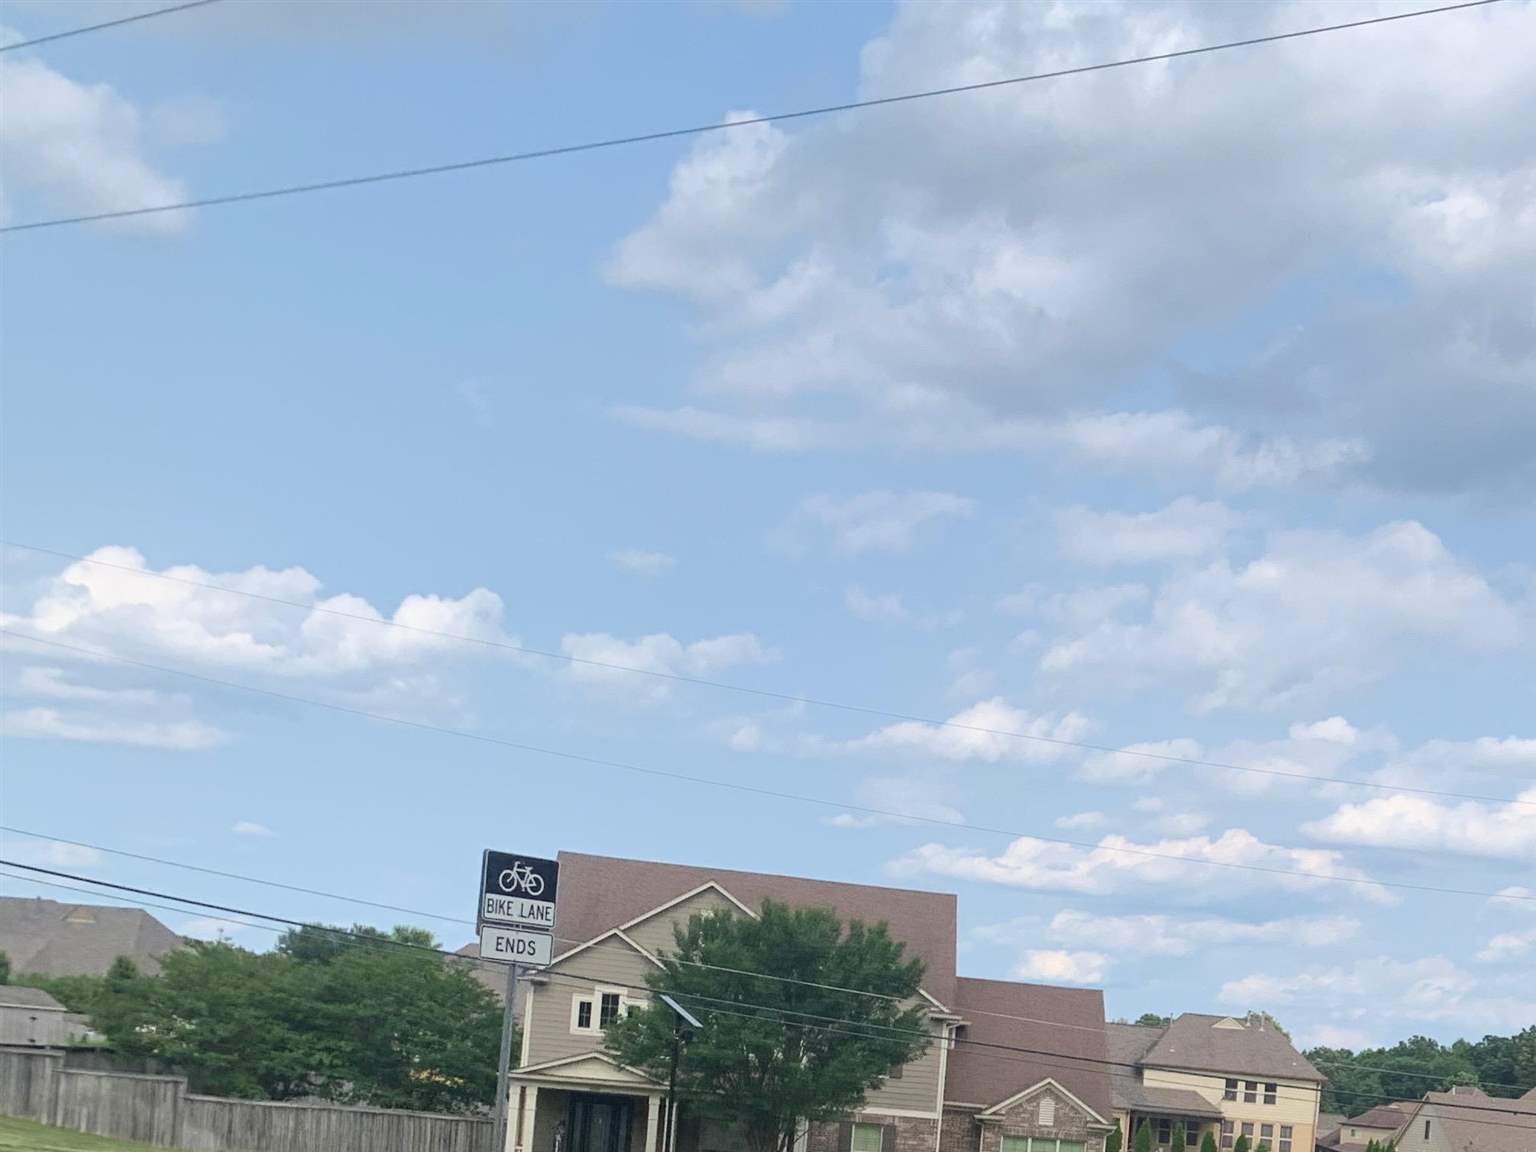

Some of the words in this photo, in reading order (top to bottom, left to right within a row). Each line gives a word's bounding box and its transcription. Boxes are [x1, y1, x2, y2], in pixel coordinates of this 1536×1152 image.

[486, 898, 514, 917] BIKE
[520, 903, 552, 922] LANE
[495, 936, 536, 956] ENDS
